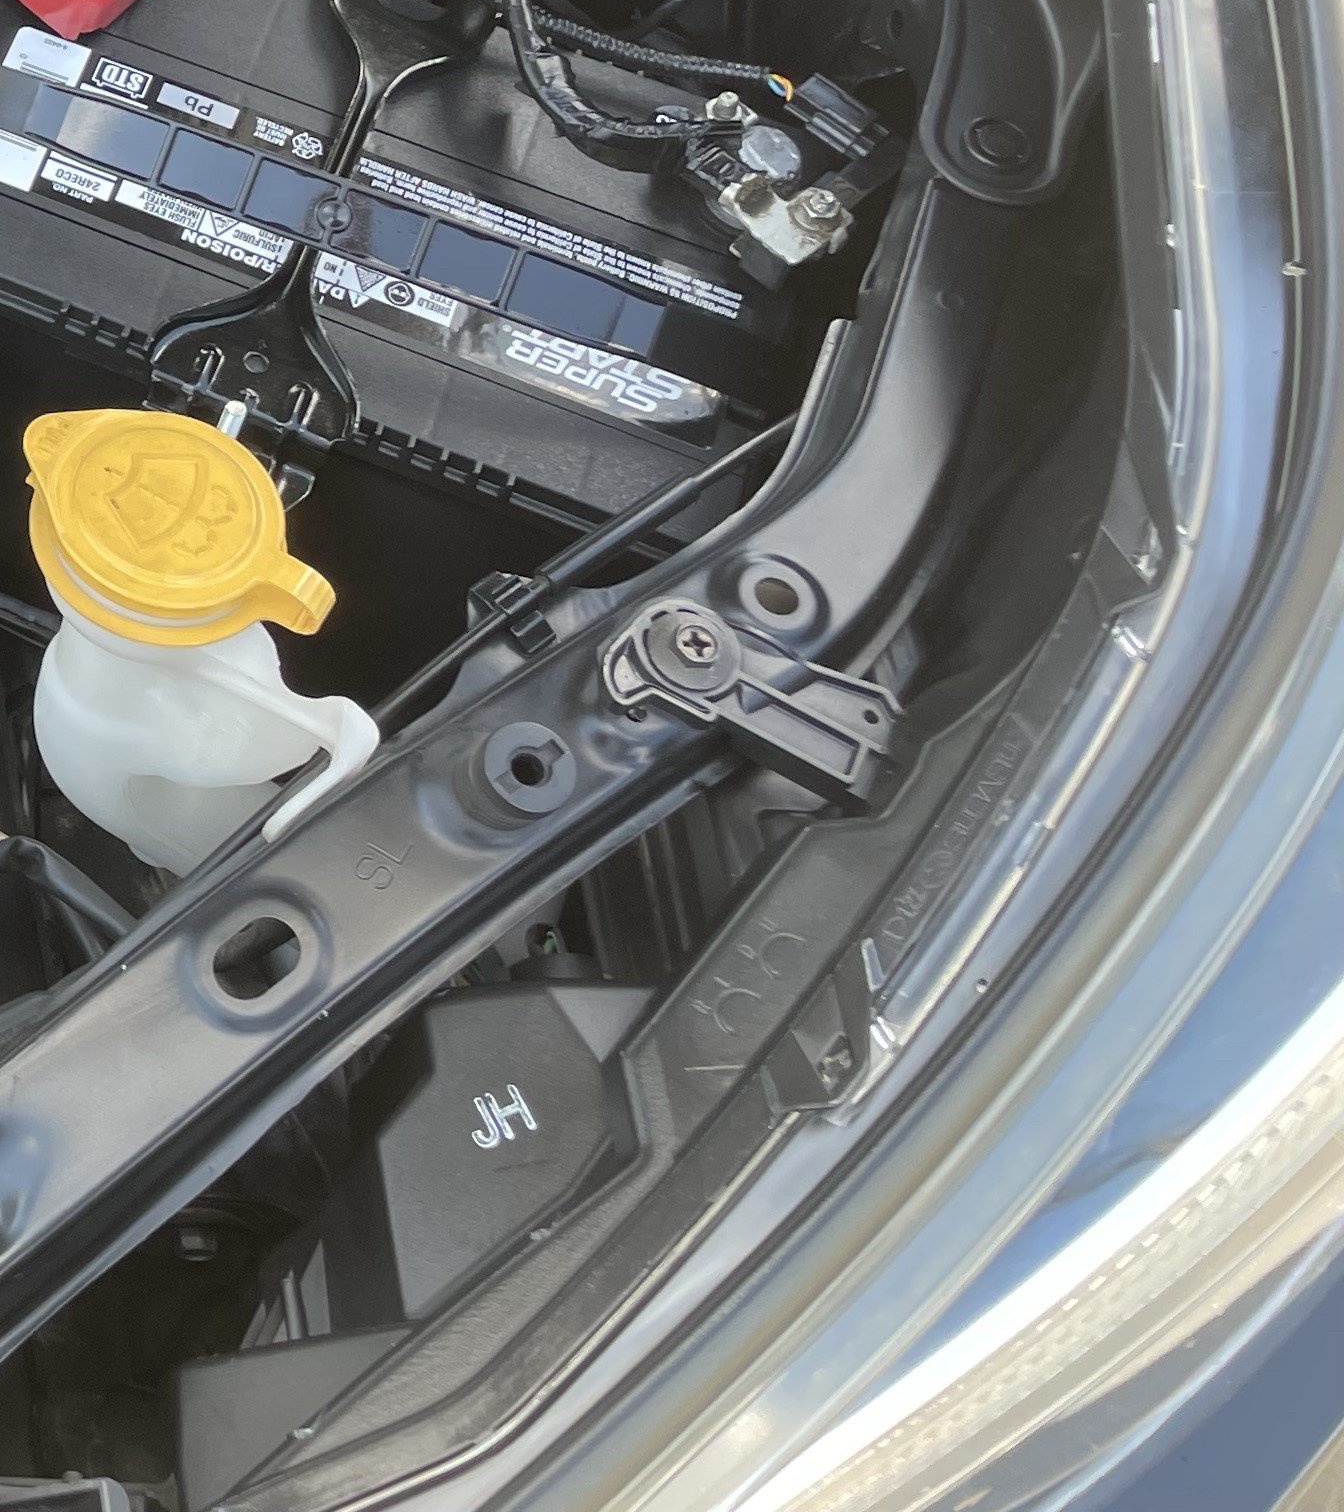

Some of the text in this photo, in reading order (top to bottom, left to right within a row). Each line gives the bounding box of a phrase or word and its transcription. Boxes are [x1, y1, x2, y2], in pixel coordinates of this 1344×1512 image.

[100, 62, 145, 92] STD
[181, 94, 213, 117] Pb
[66, 187, 94, 203] PART
[138, 189, 200, 219] IMMEDIATELY
[142, 200, 197, 228] FLUSH EYES
[179, 227, 280, 275] R/POISON
[232, 228, 277, 252] SULFURIC
[416, 296, 451, 316] SHIELD
[503, 335, 663, 415] SUPER
[356, 841, 413, 893] SL
[470, 1083, 537, 1150] JH
